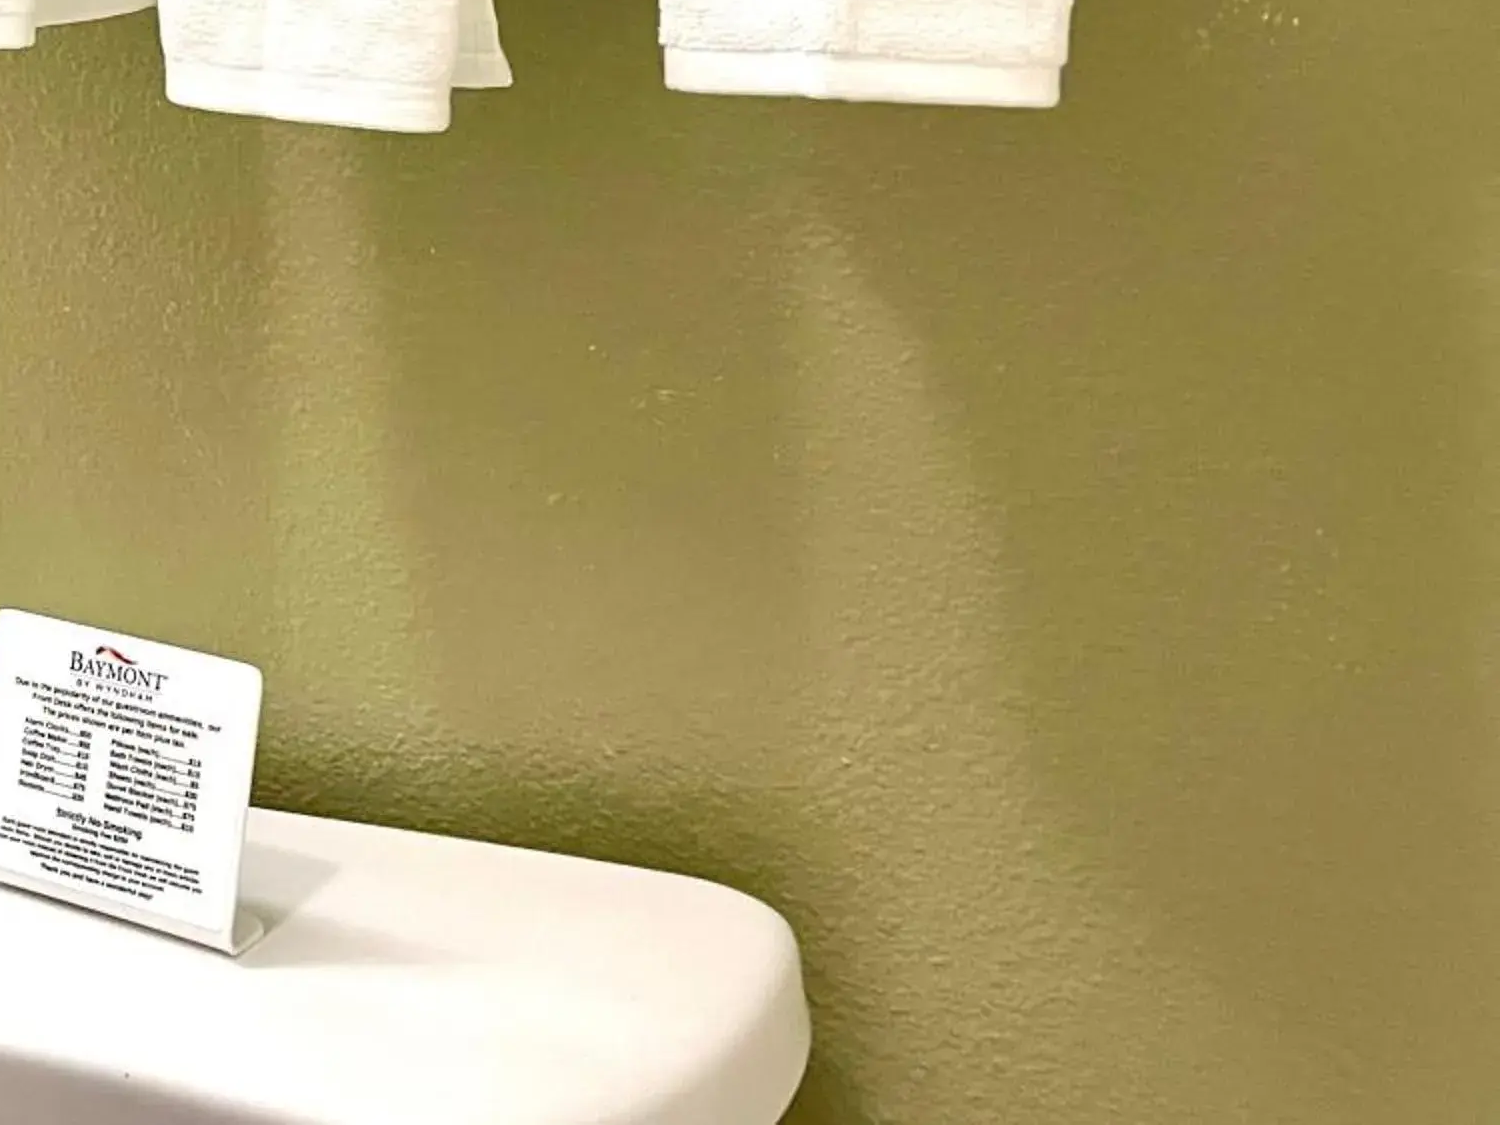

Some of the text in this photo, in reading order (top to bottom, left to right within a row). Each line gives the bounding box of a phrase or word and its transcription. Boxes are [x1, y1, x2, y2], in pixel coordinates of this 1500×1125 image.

[70, 650, 166, 691] BAYMONT
[76, 678, 153, 702] BY WYNDHAM
[56, 807, 87, 825] Strictly
[88, 816, 103, 828] No
[101, 820, 143, 841] Smoking
